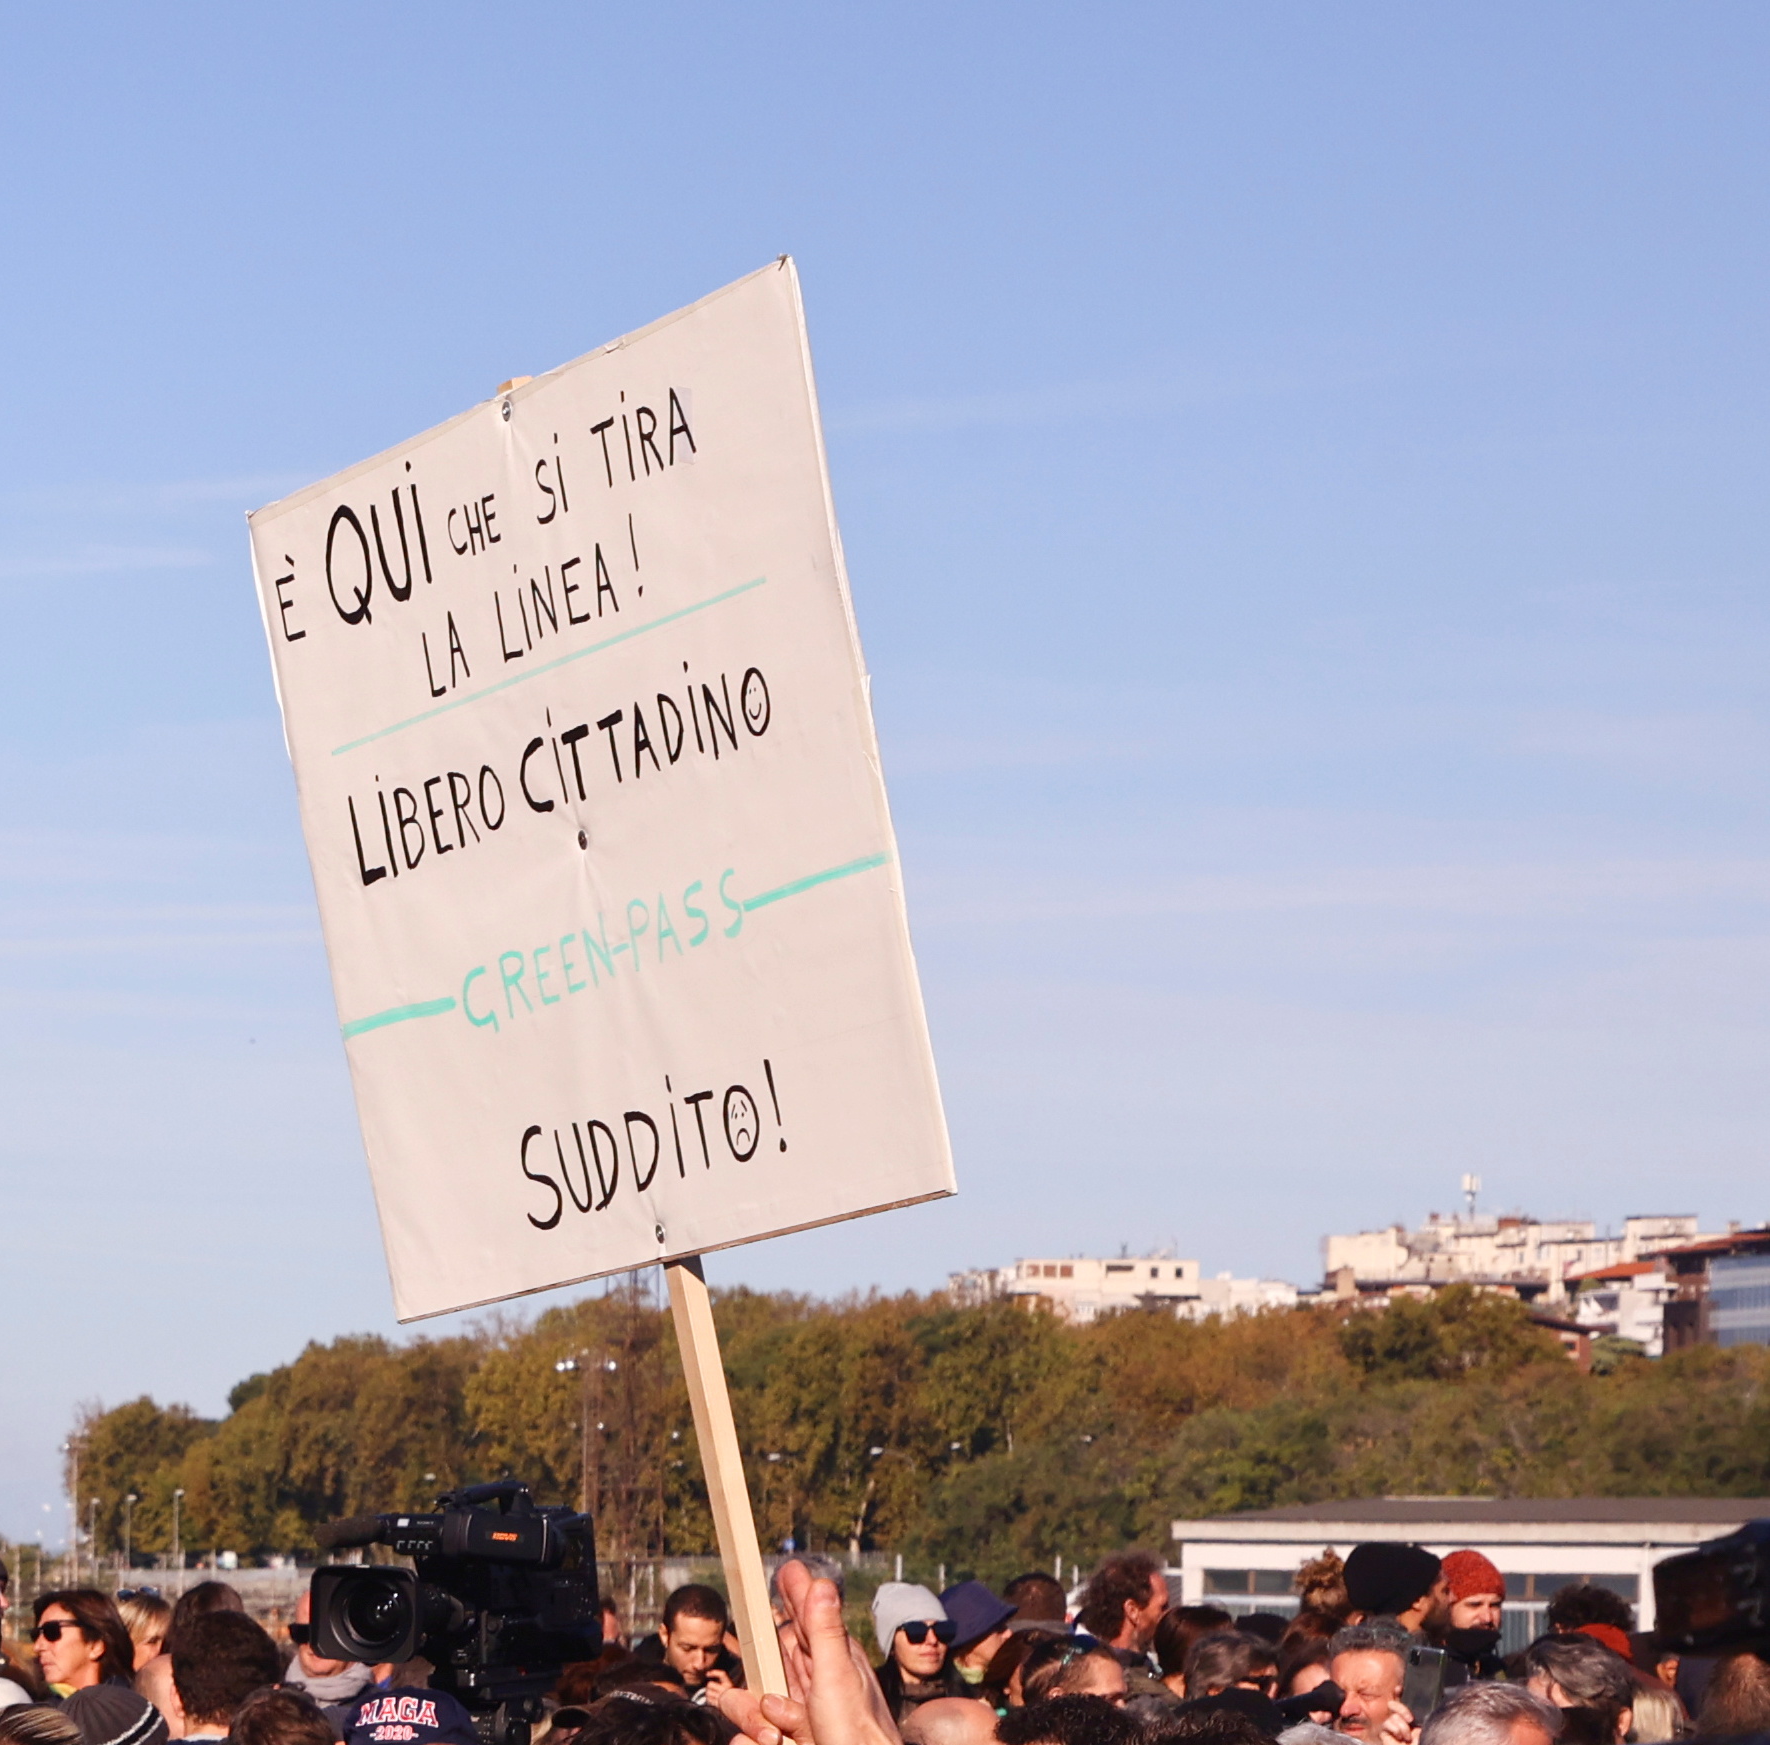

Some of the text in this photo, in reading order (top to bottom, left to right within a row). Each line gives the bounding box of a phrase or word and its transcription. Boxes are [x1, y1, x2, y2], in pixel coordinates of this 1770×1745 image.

[449, 493, 502, 556] CHE
[422, 611, 471, 698] LA
[463, 867, 747, 1032] GREEN-PASS
[355, 1696, 440, 1728] MAGA
